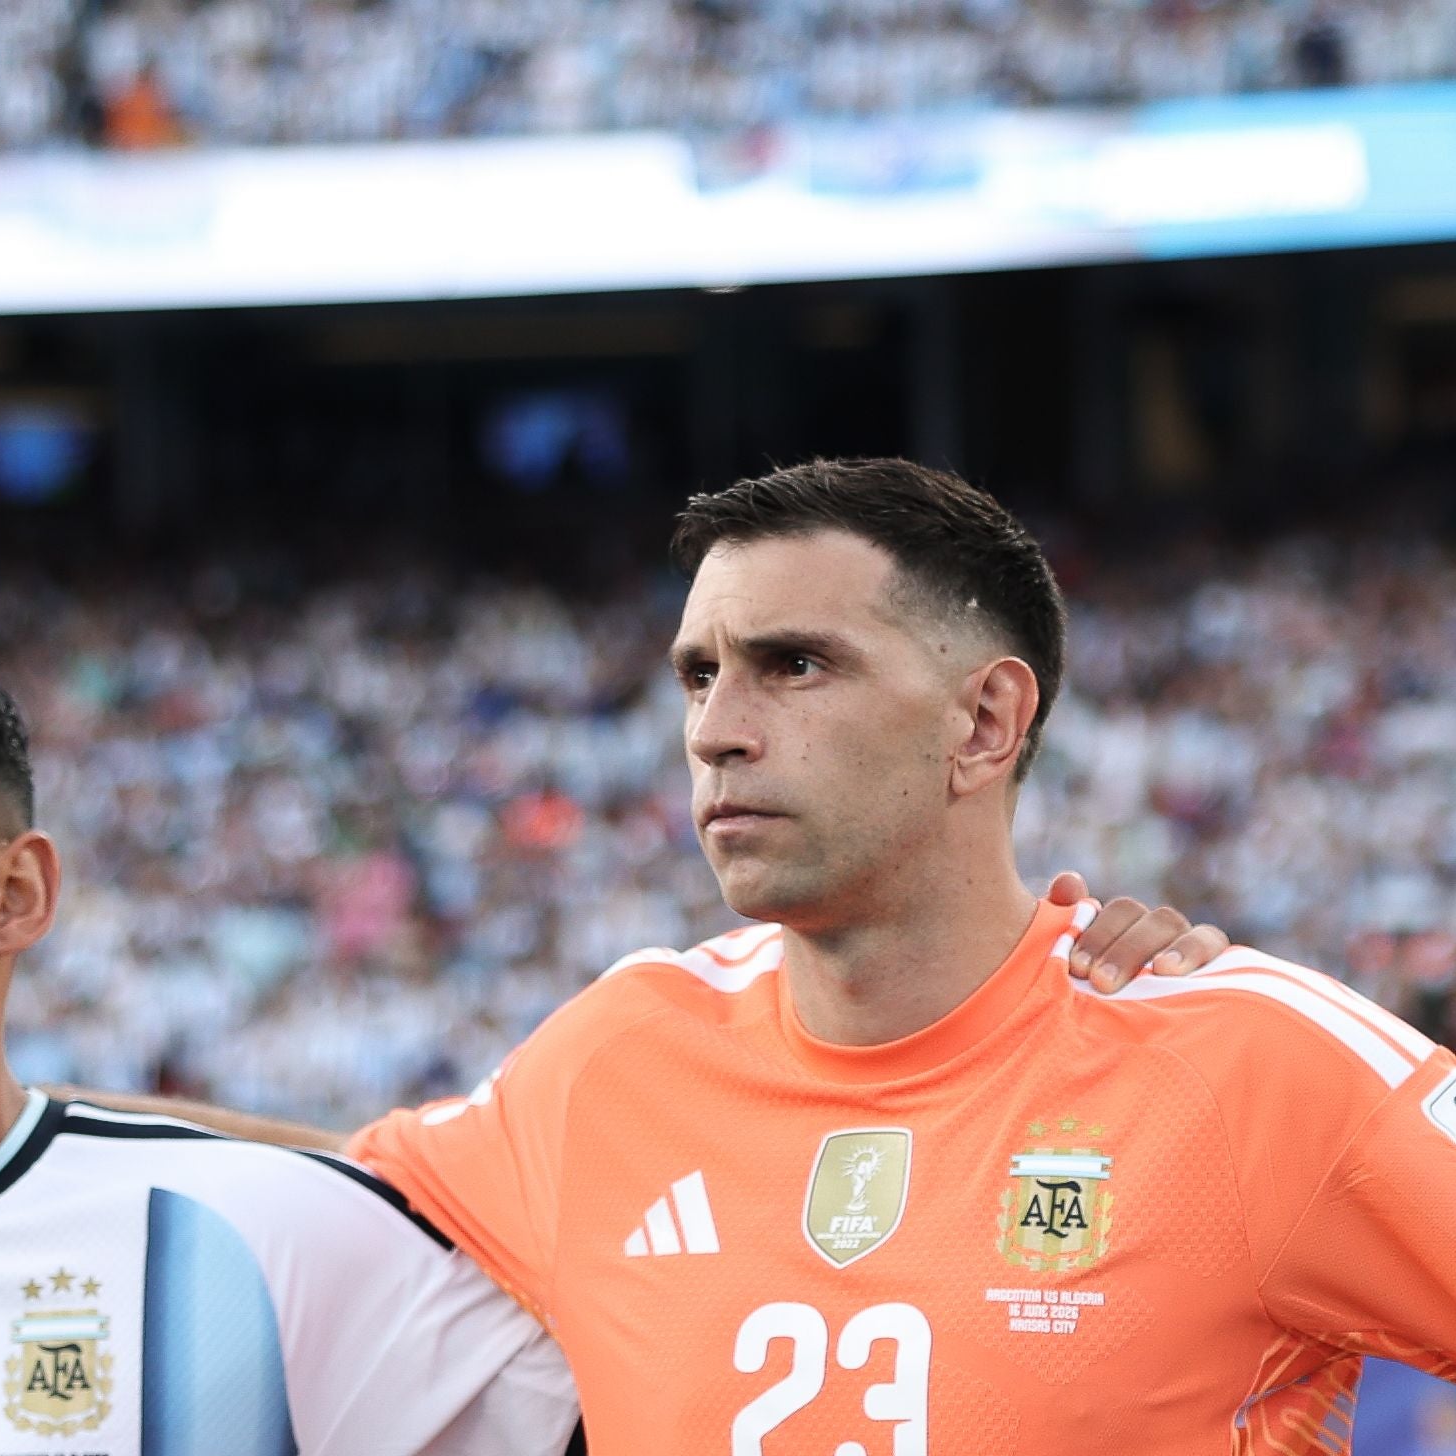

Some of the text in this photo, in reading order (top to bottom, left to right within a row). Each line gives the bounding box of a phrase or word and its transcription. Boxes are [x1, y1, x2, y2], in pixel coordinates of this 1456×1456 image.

[829, 1215, 874, 1233] FIFA
[1020, 1179, 1089, 1239] AFA
[27, 1343, 91, 1400] AFA
